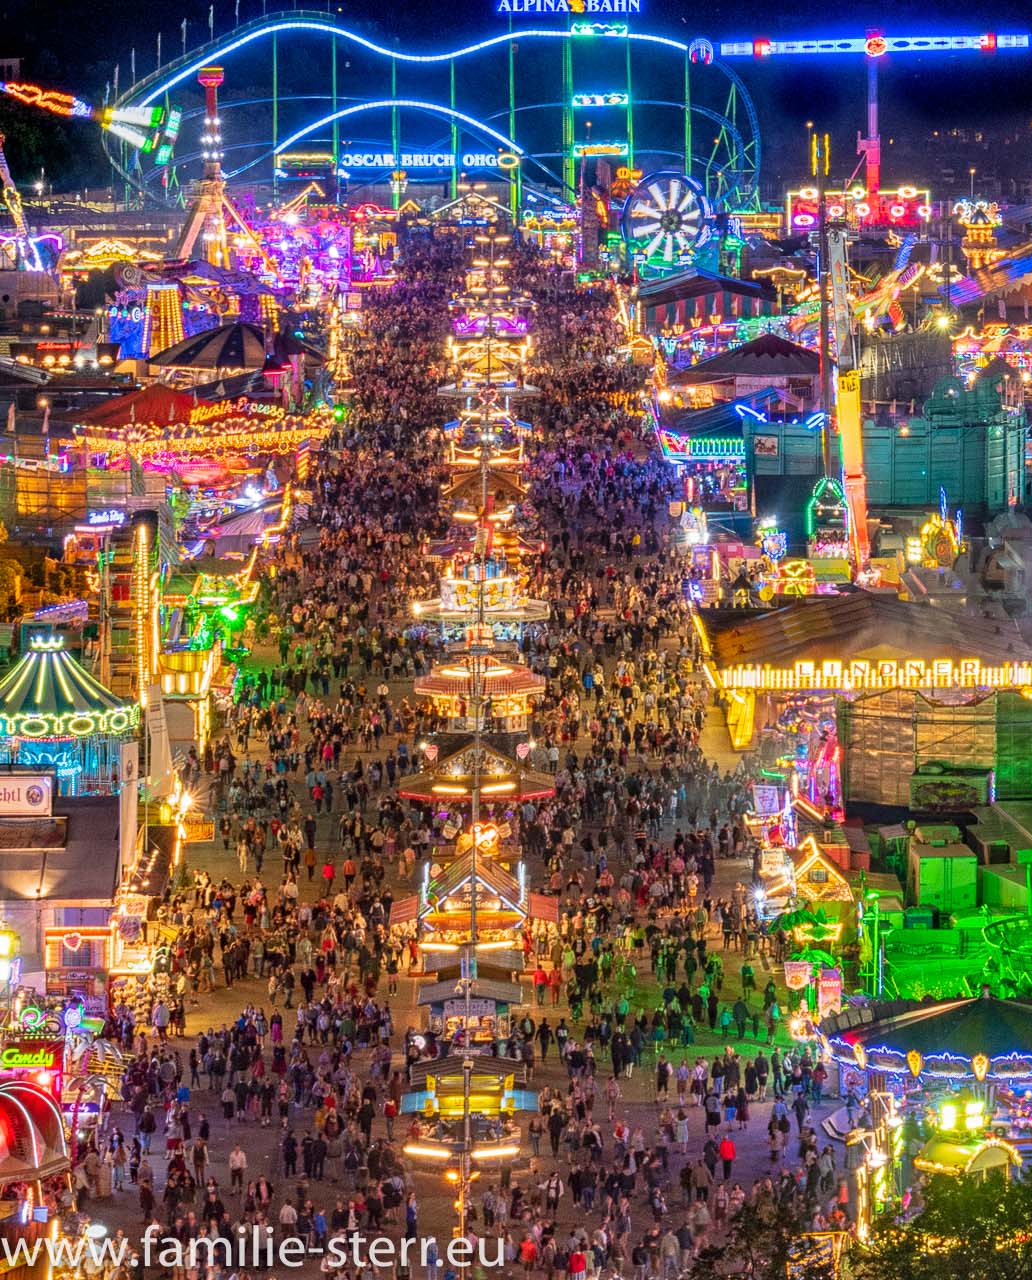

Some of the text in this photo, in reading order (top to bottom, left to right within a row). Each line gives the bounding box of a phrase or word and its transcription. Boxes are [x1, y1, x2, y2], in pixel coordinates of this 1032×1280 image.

[342, 153, 498, 167] OSCAR BRUCH OHG
[798, 662, 977, 677] LINDNER
[2, 1048, 54, 1067] Candy
